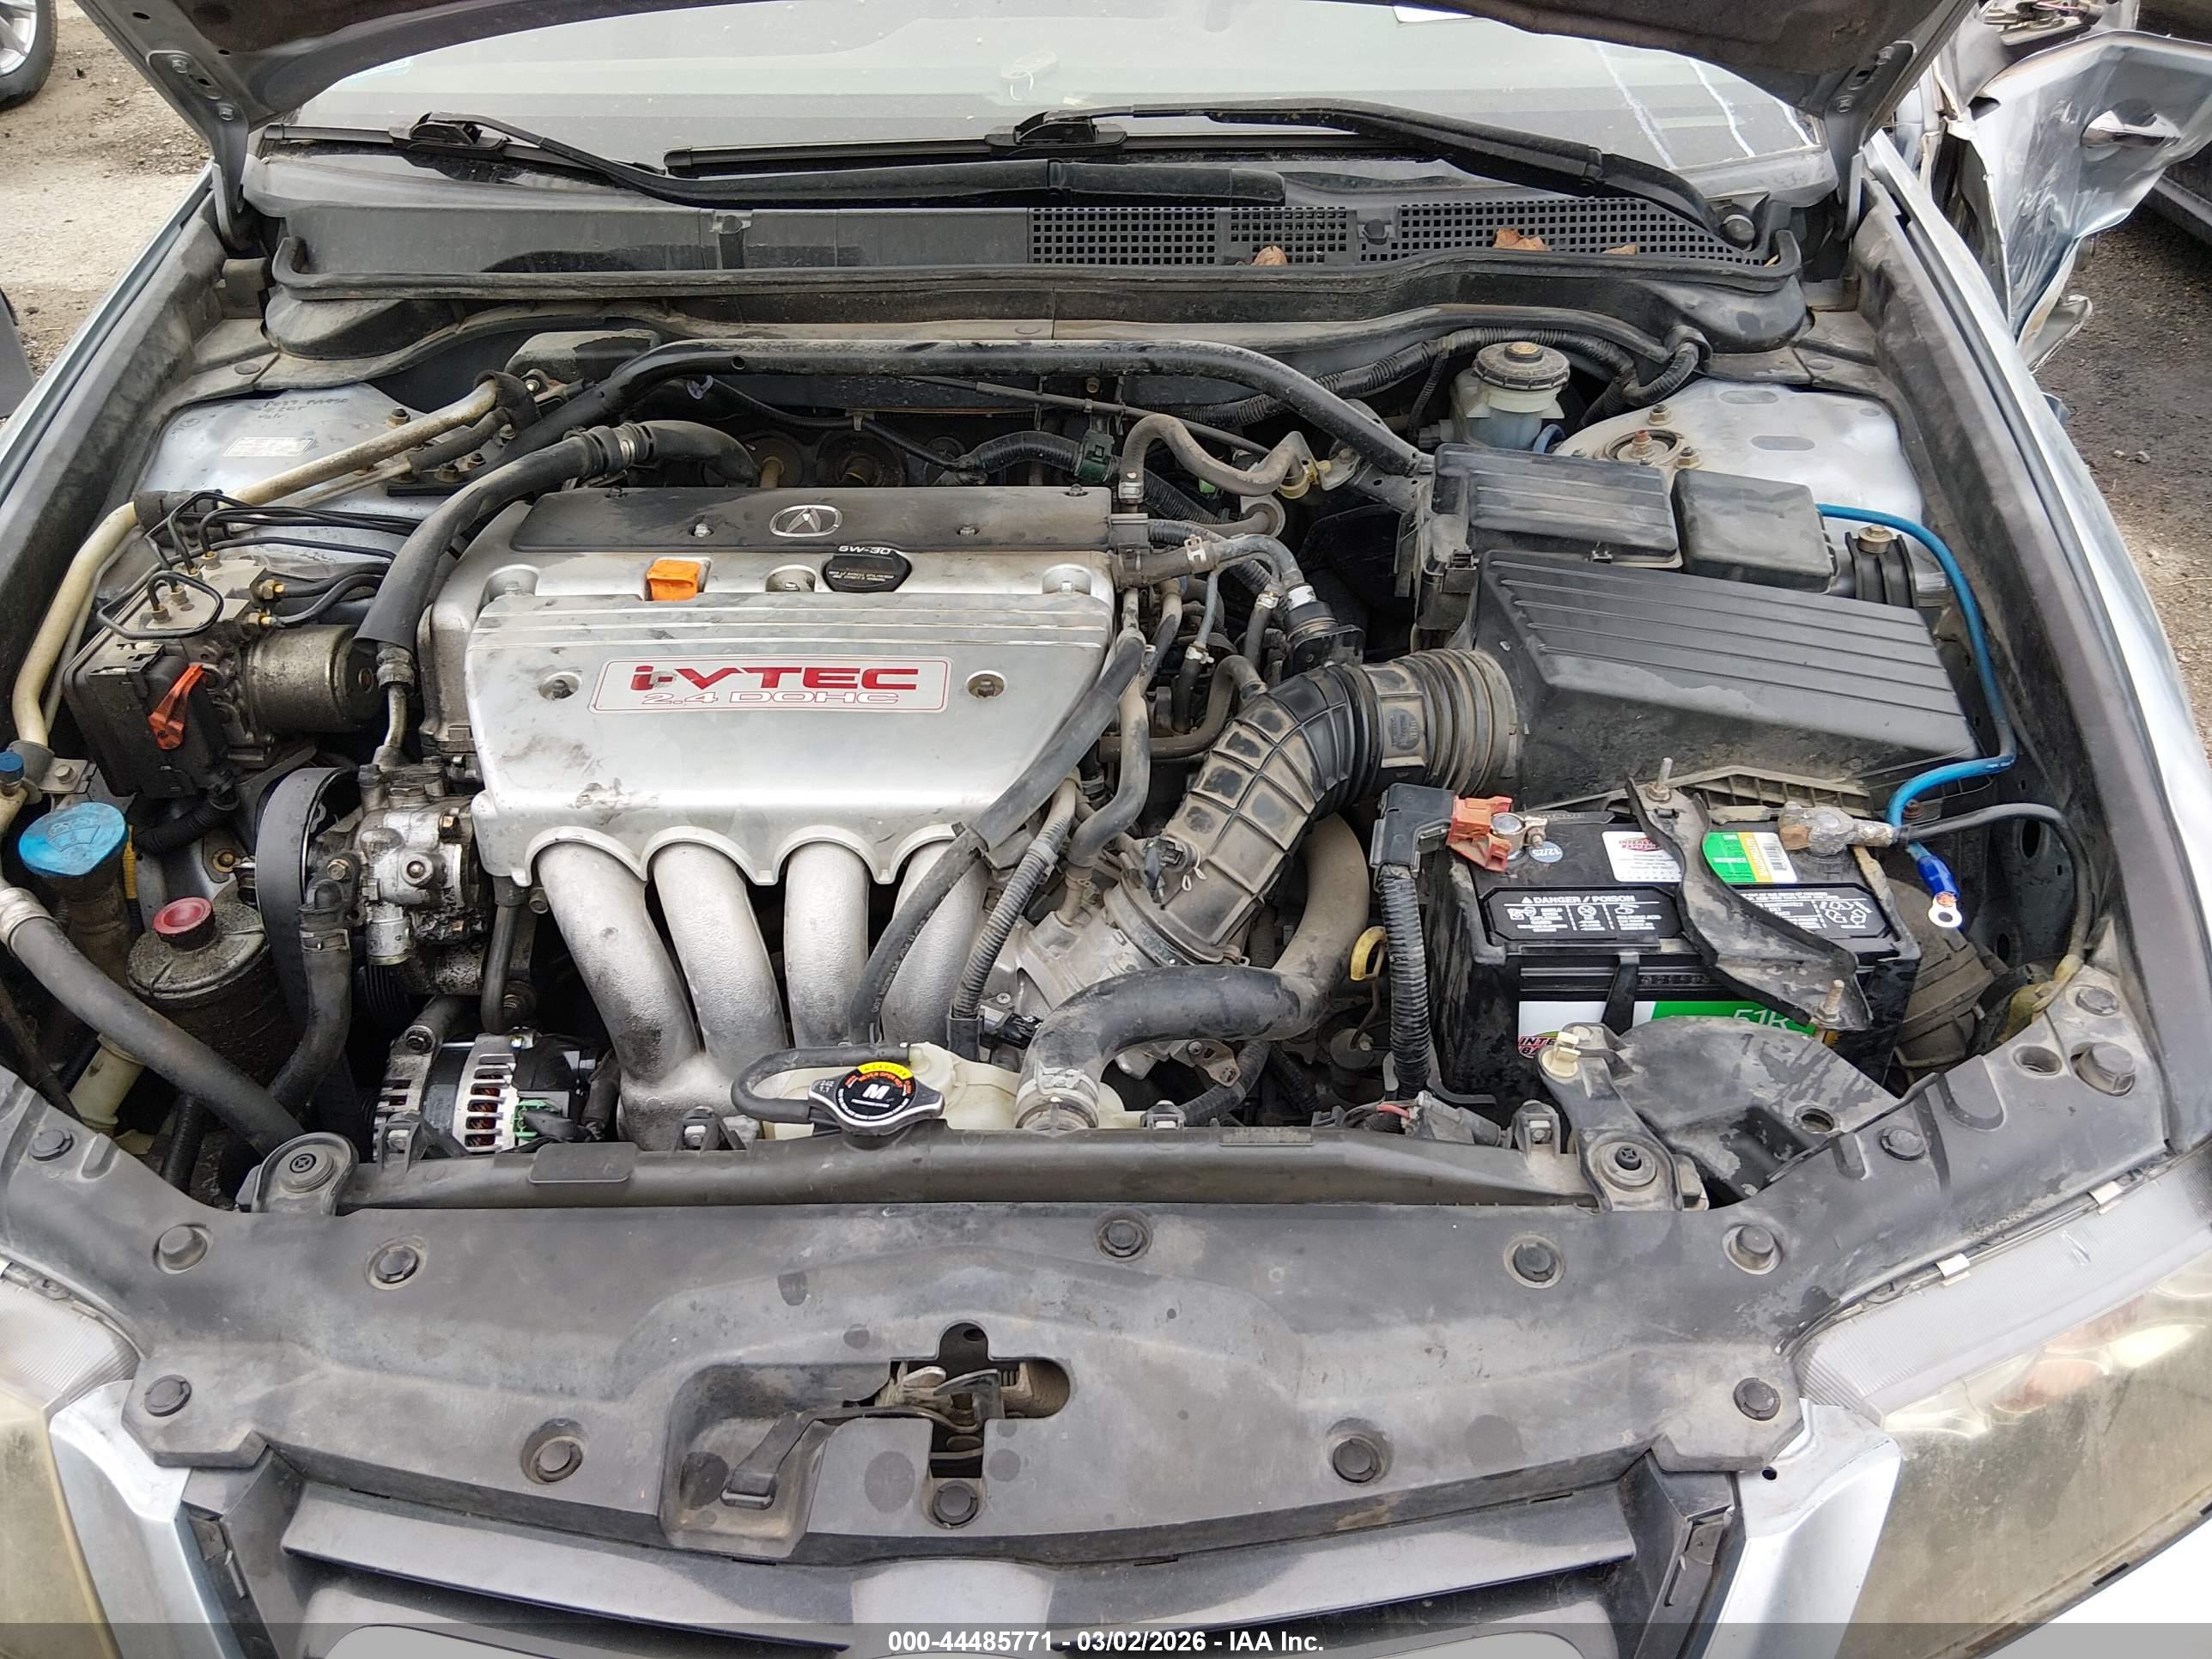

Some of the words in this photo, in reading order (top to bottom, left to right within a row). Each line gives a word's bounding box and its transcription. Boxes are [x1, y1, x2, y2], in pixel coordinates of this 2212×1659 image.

[838, 545, 891, 555] 5W-30
[630, 665, 919, 690] i-VTEC
[641, 691, 719, 705] 2.4
[728, 690, 900, 705] DOHC
[872, 1064, 908, 1078] CAUTION
